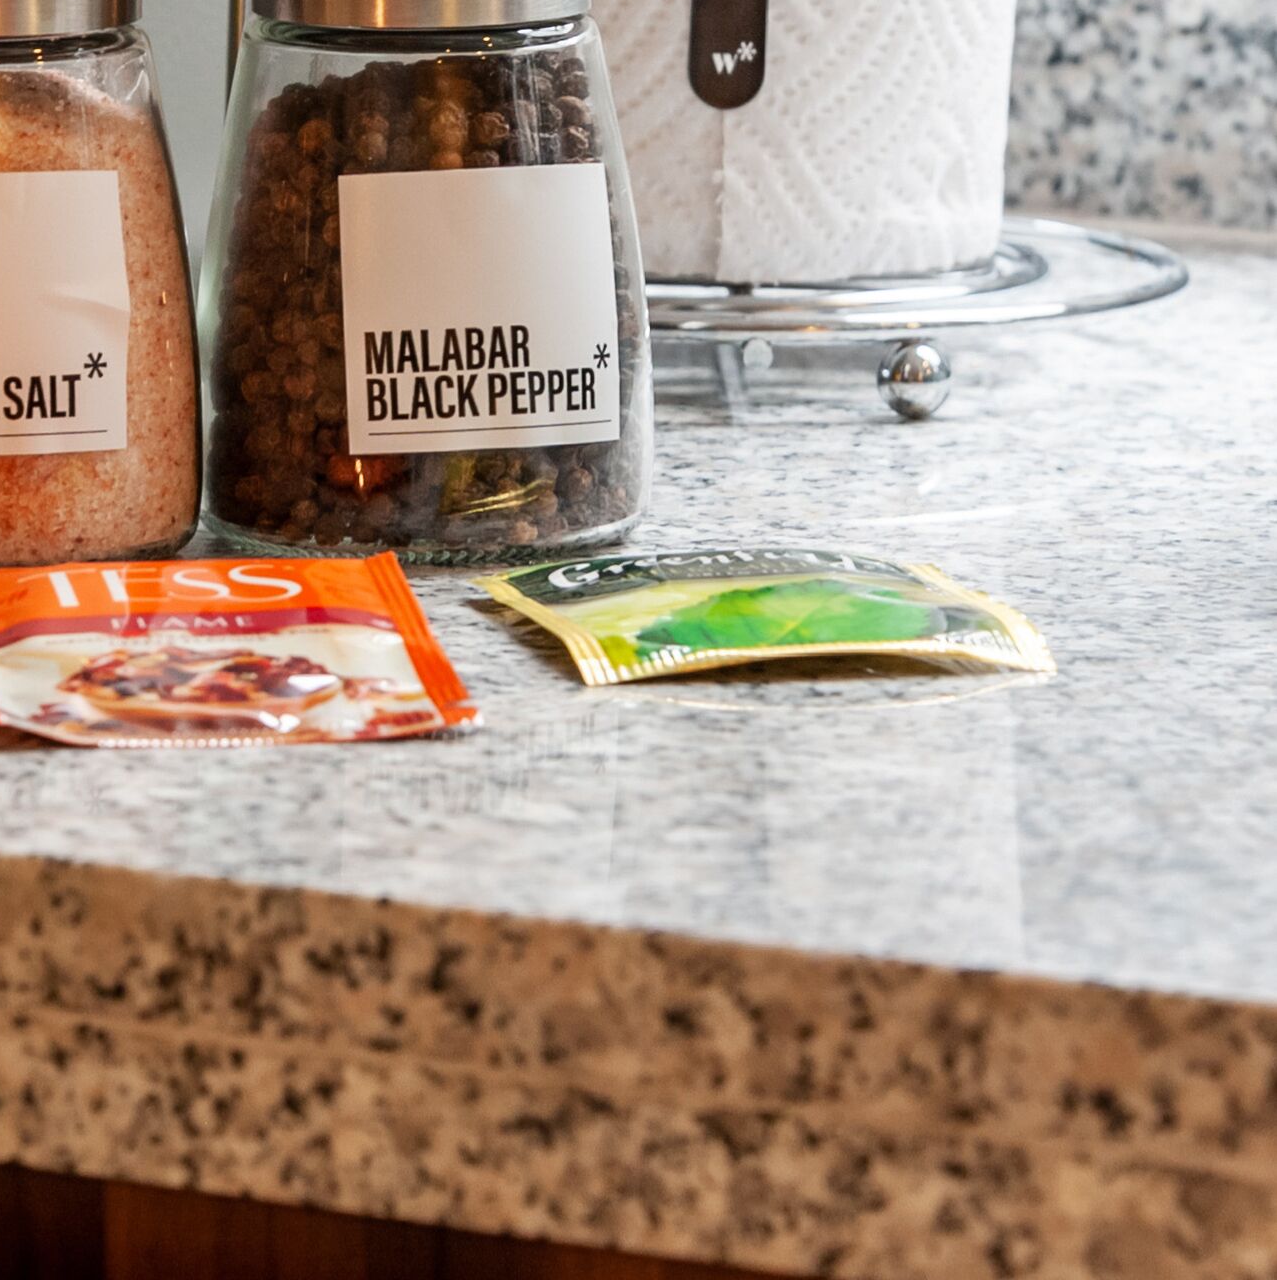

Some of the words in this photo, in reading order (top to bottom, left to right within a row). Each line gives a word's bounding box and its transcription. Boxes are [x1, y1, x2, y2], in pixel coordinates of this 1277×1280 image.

[364, 325, 530, 375] MALABAR
[366, 373, 480, 422] BLACK
[28, 564, 303, 608] TESS
